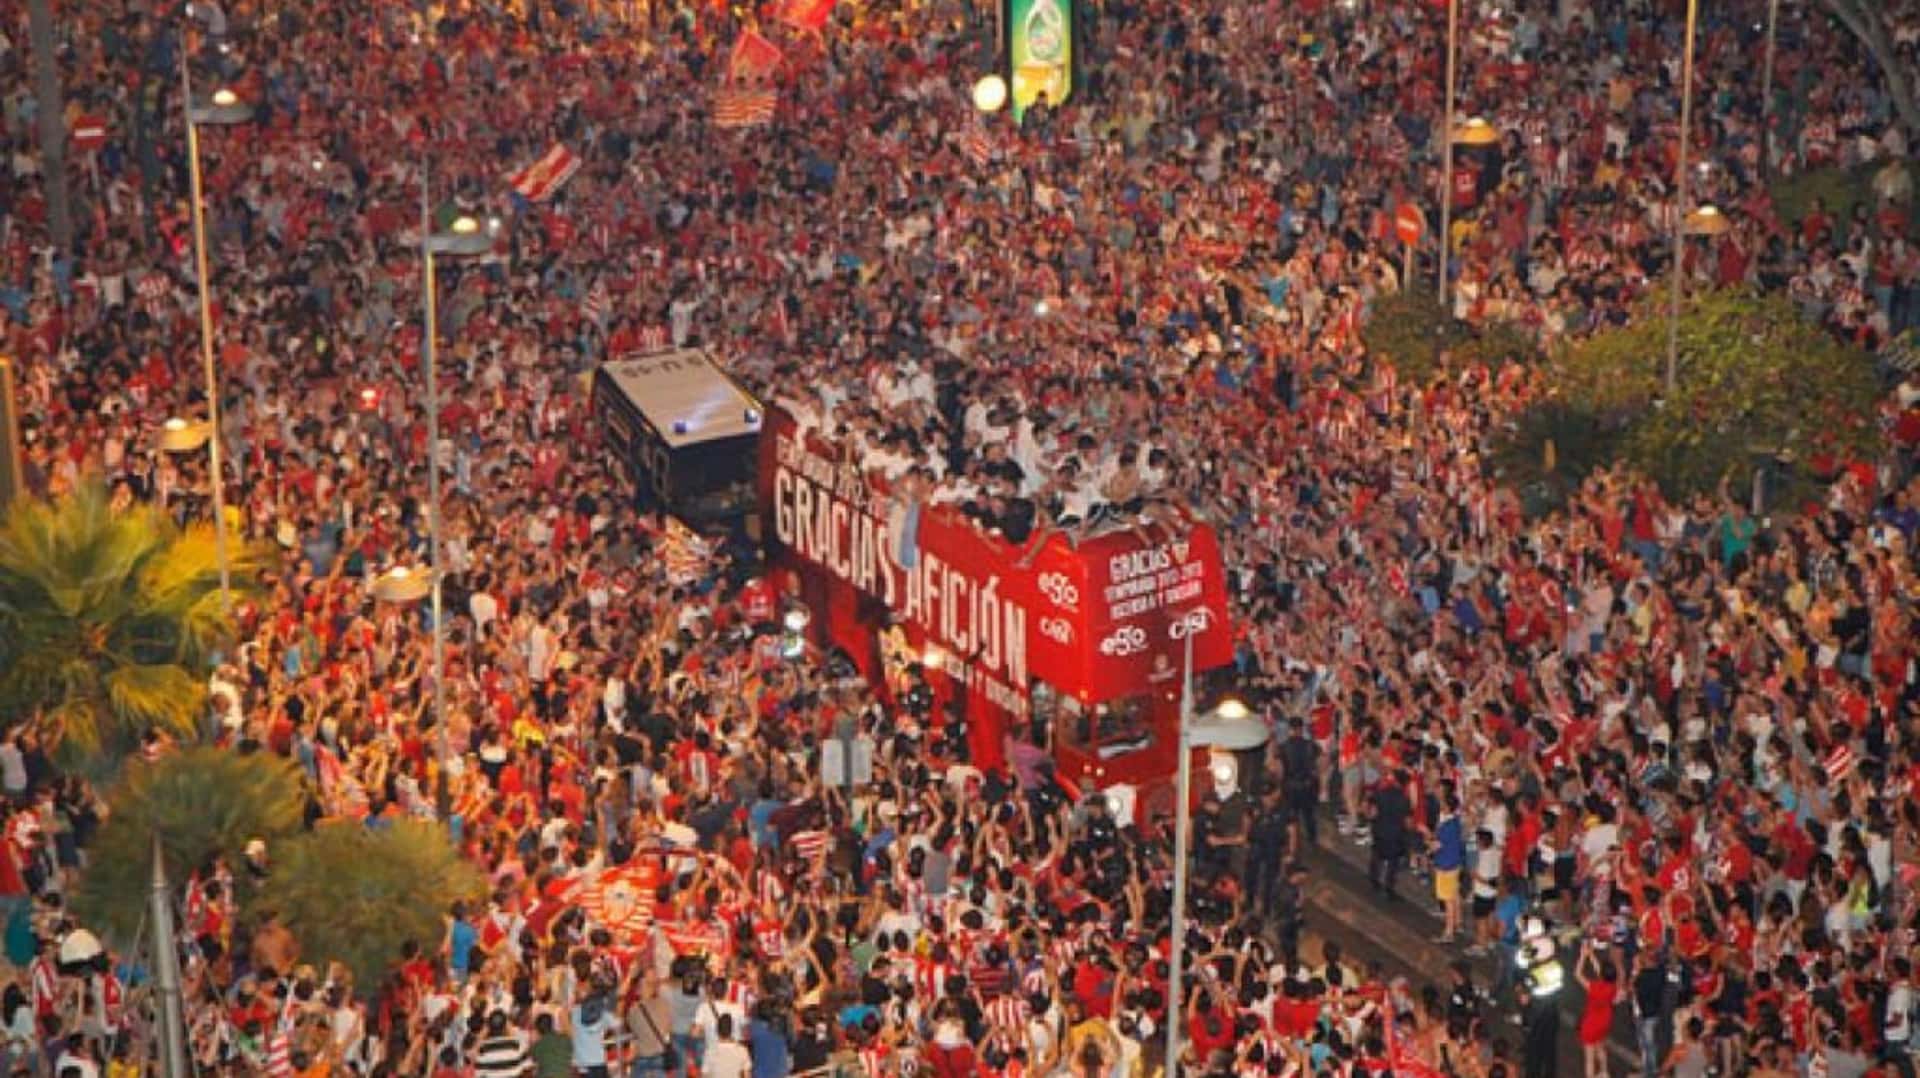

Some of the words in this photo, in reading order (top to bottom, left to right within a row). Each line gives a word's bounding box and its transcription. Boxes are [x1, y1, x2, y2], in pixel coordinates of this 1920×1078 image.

[775, 465, 896, 606] GRACIAS
[905, 552, 1027, 688] AFICIÓN
[1110, 544, 1170, 584] GRACIAS
